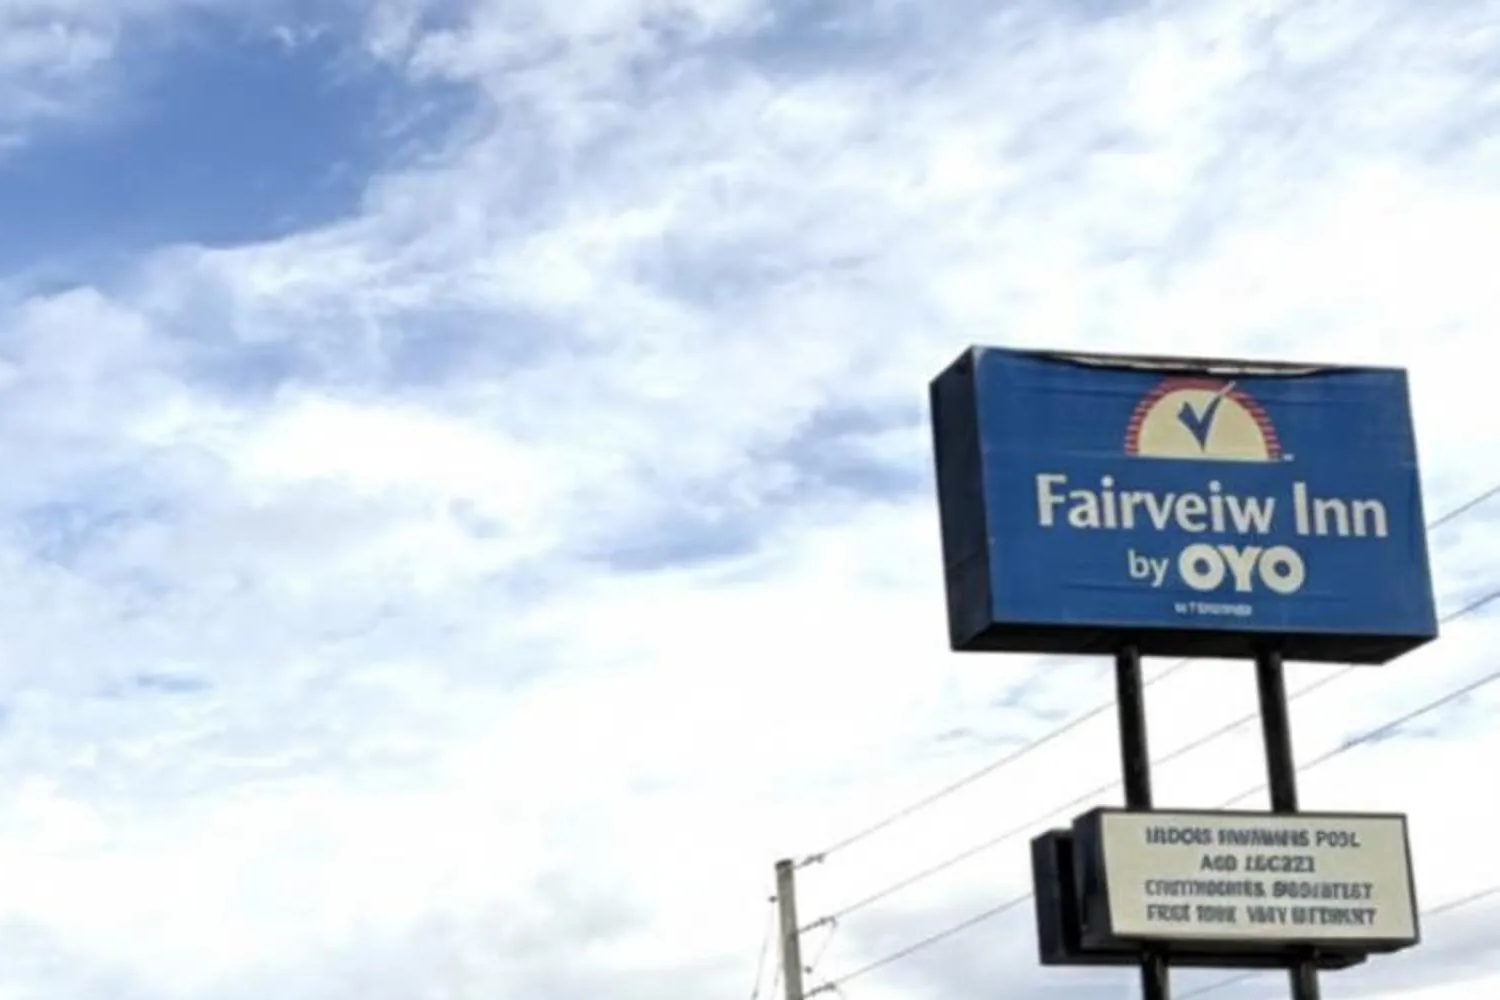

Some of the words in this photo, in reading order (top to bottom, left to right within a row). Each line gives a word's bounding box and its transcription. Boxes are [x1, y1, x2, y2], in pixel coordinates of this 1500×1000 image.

[1036, 472, 1275, 534] Fairveiw
[1292, 481, 1388, 537] Inn
[1127, 549, 1169, 588] by
[1178, 543, 1305, 594] OYO
